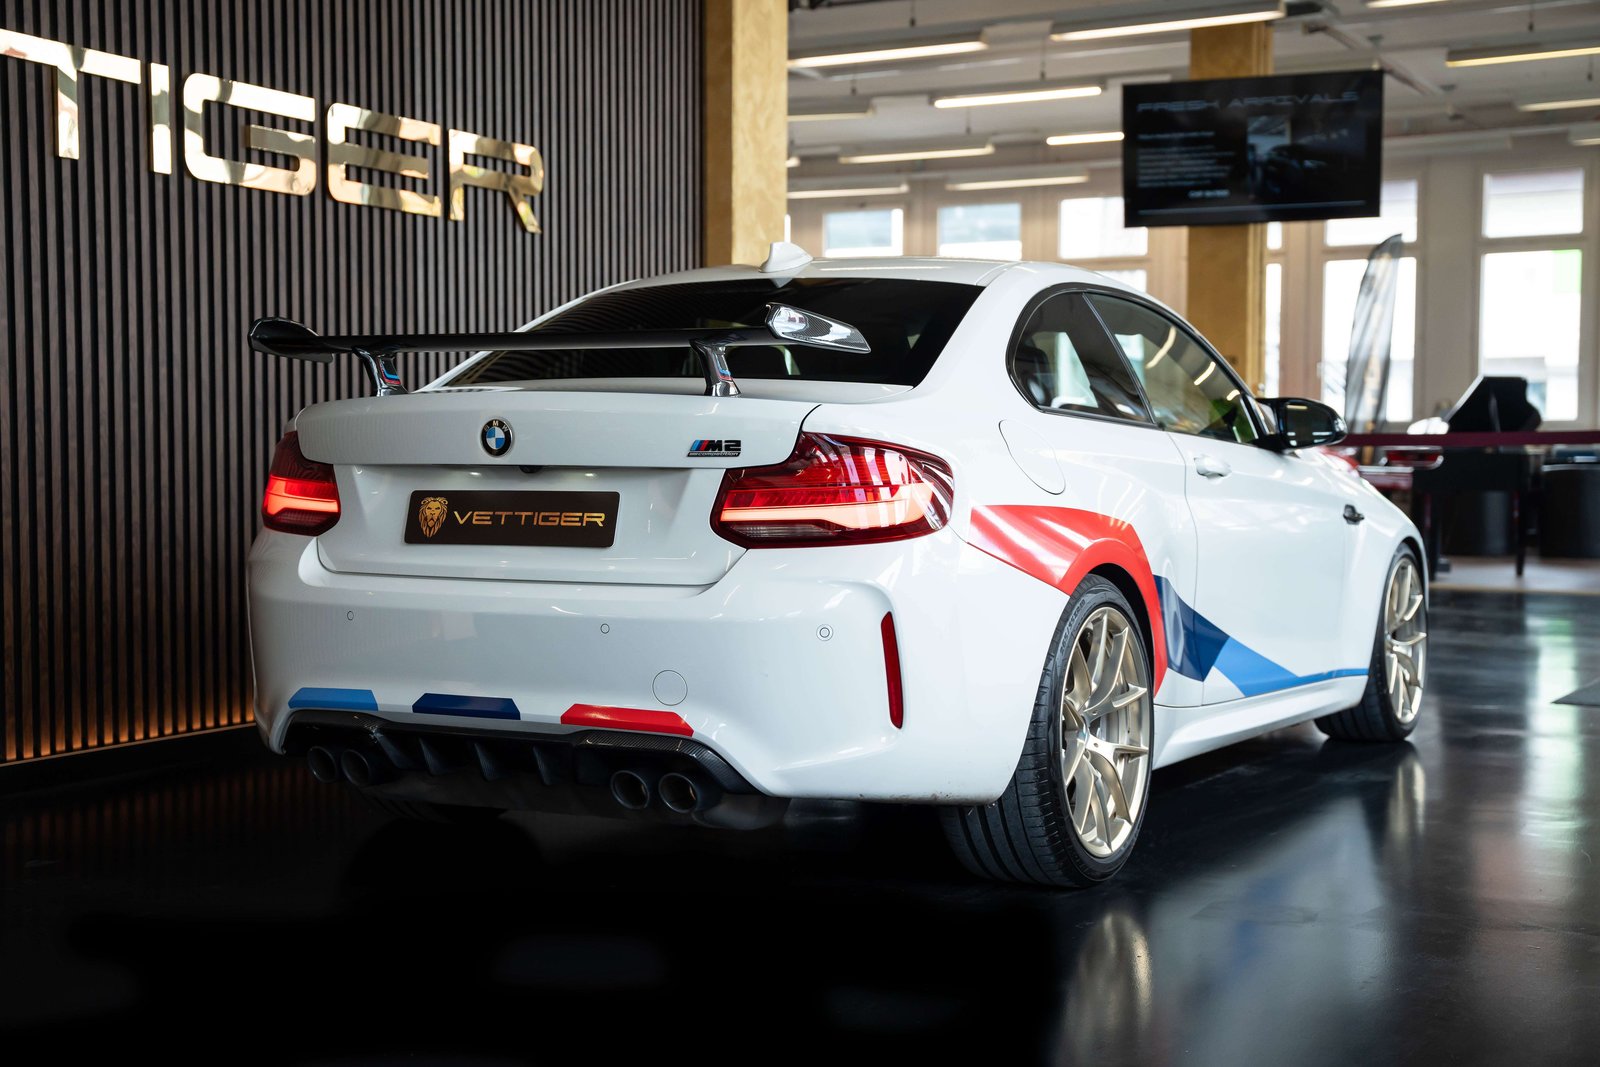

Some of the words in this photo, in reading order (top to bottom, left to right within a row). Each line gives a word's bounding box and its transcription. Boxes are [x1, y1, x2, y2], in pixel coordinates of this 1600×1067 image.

[0, 28, 544, 234] TIGER
[702, 439, 742, 451] M2
[453, 510, 606, 527] VETTIGER
